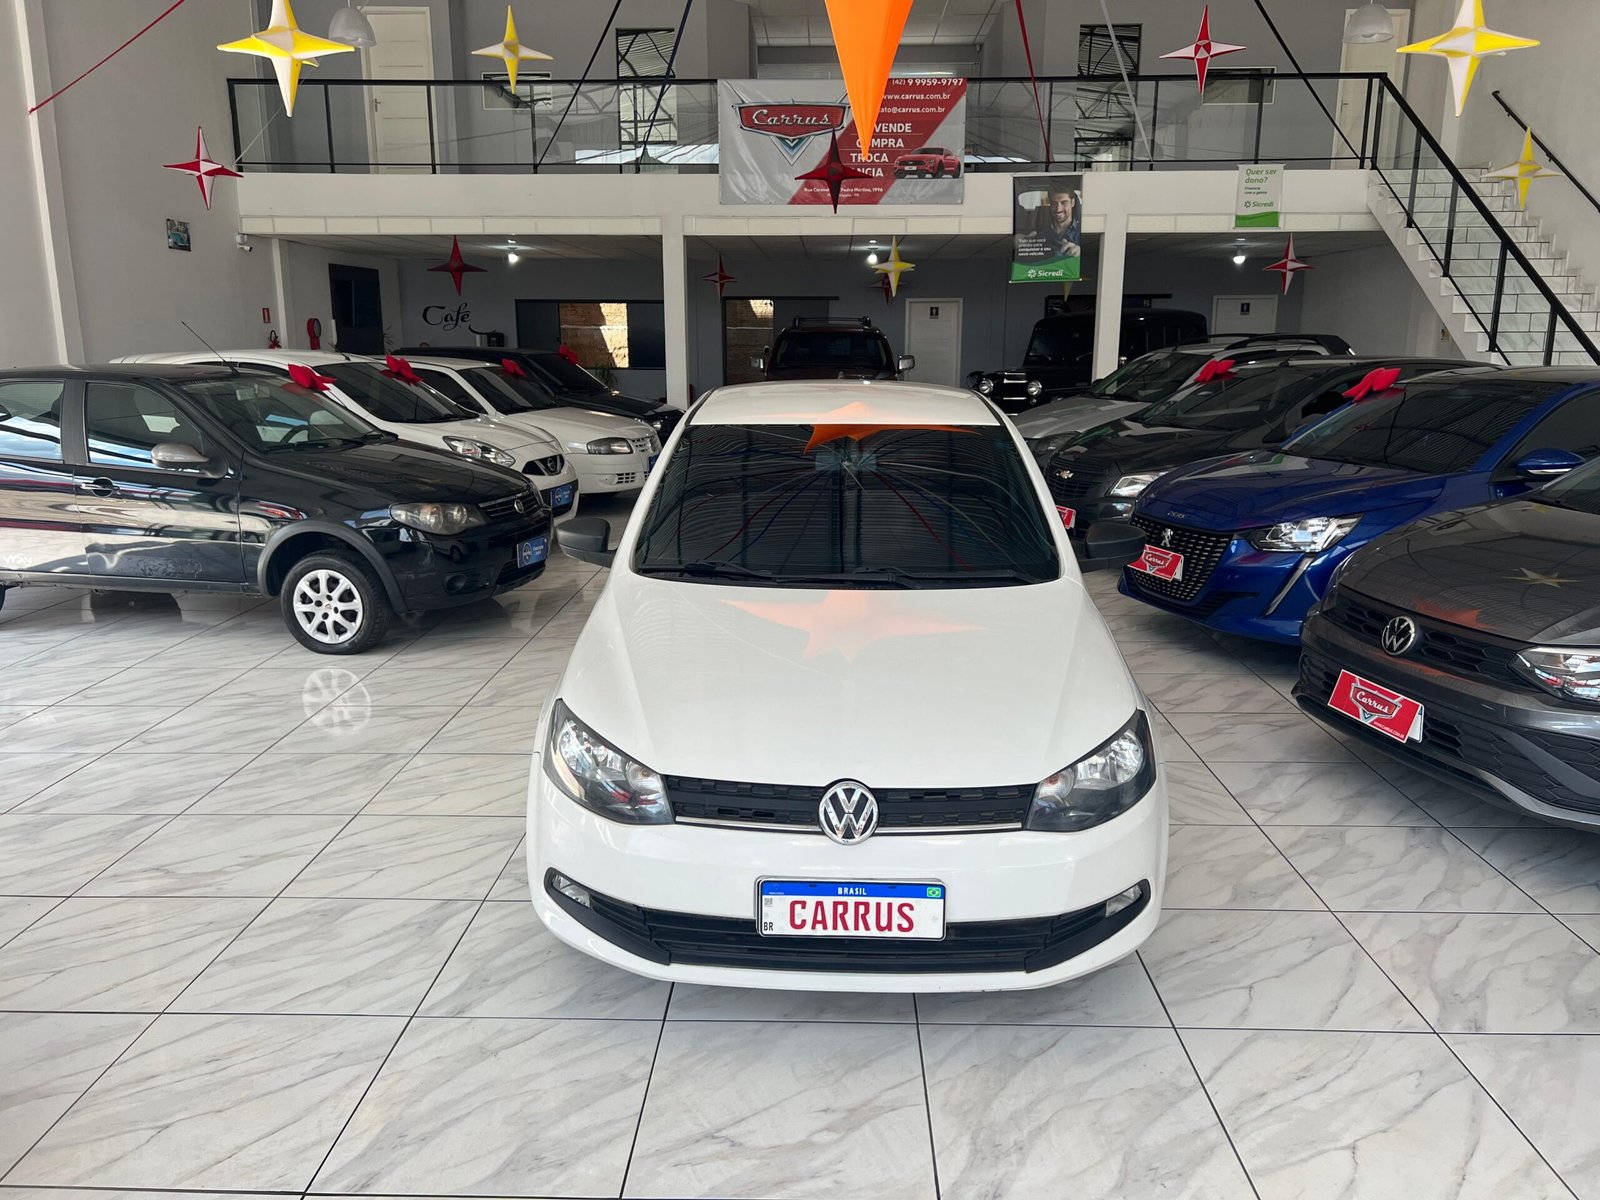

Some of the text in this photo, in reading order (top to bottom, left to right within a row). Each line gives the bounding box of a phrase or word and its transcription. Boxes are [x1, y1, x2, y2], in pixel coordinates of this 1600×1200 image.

[915, 78, 964, 86] 9959-9797
[752, 109, 832, 125] Carrus
[874, 123, 912, 133] VENDE
[856, 138, 905, 148] CMPRA
[1246, 168, 1264, 176] Quer
[1244, 176, 1269, 184] dono?
[1037, 269, 1064, 277] Sicredi
[1356, 691, 1389, 714] Carrus
[837, 887, 867, 896] BRASIL
[789, 900, 915, 933] CARRUS
[763, 921, 774, 931] BR
